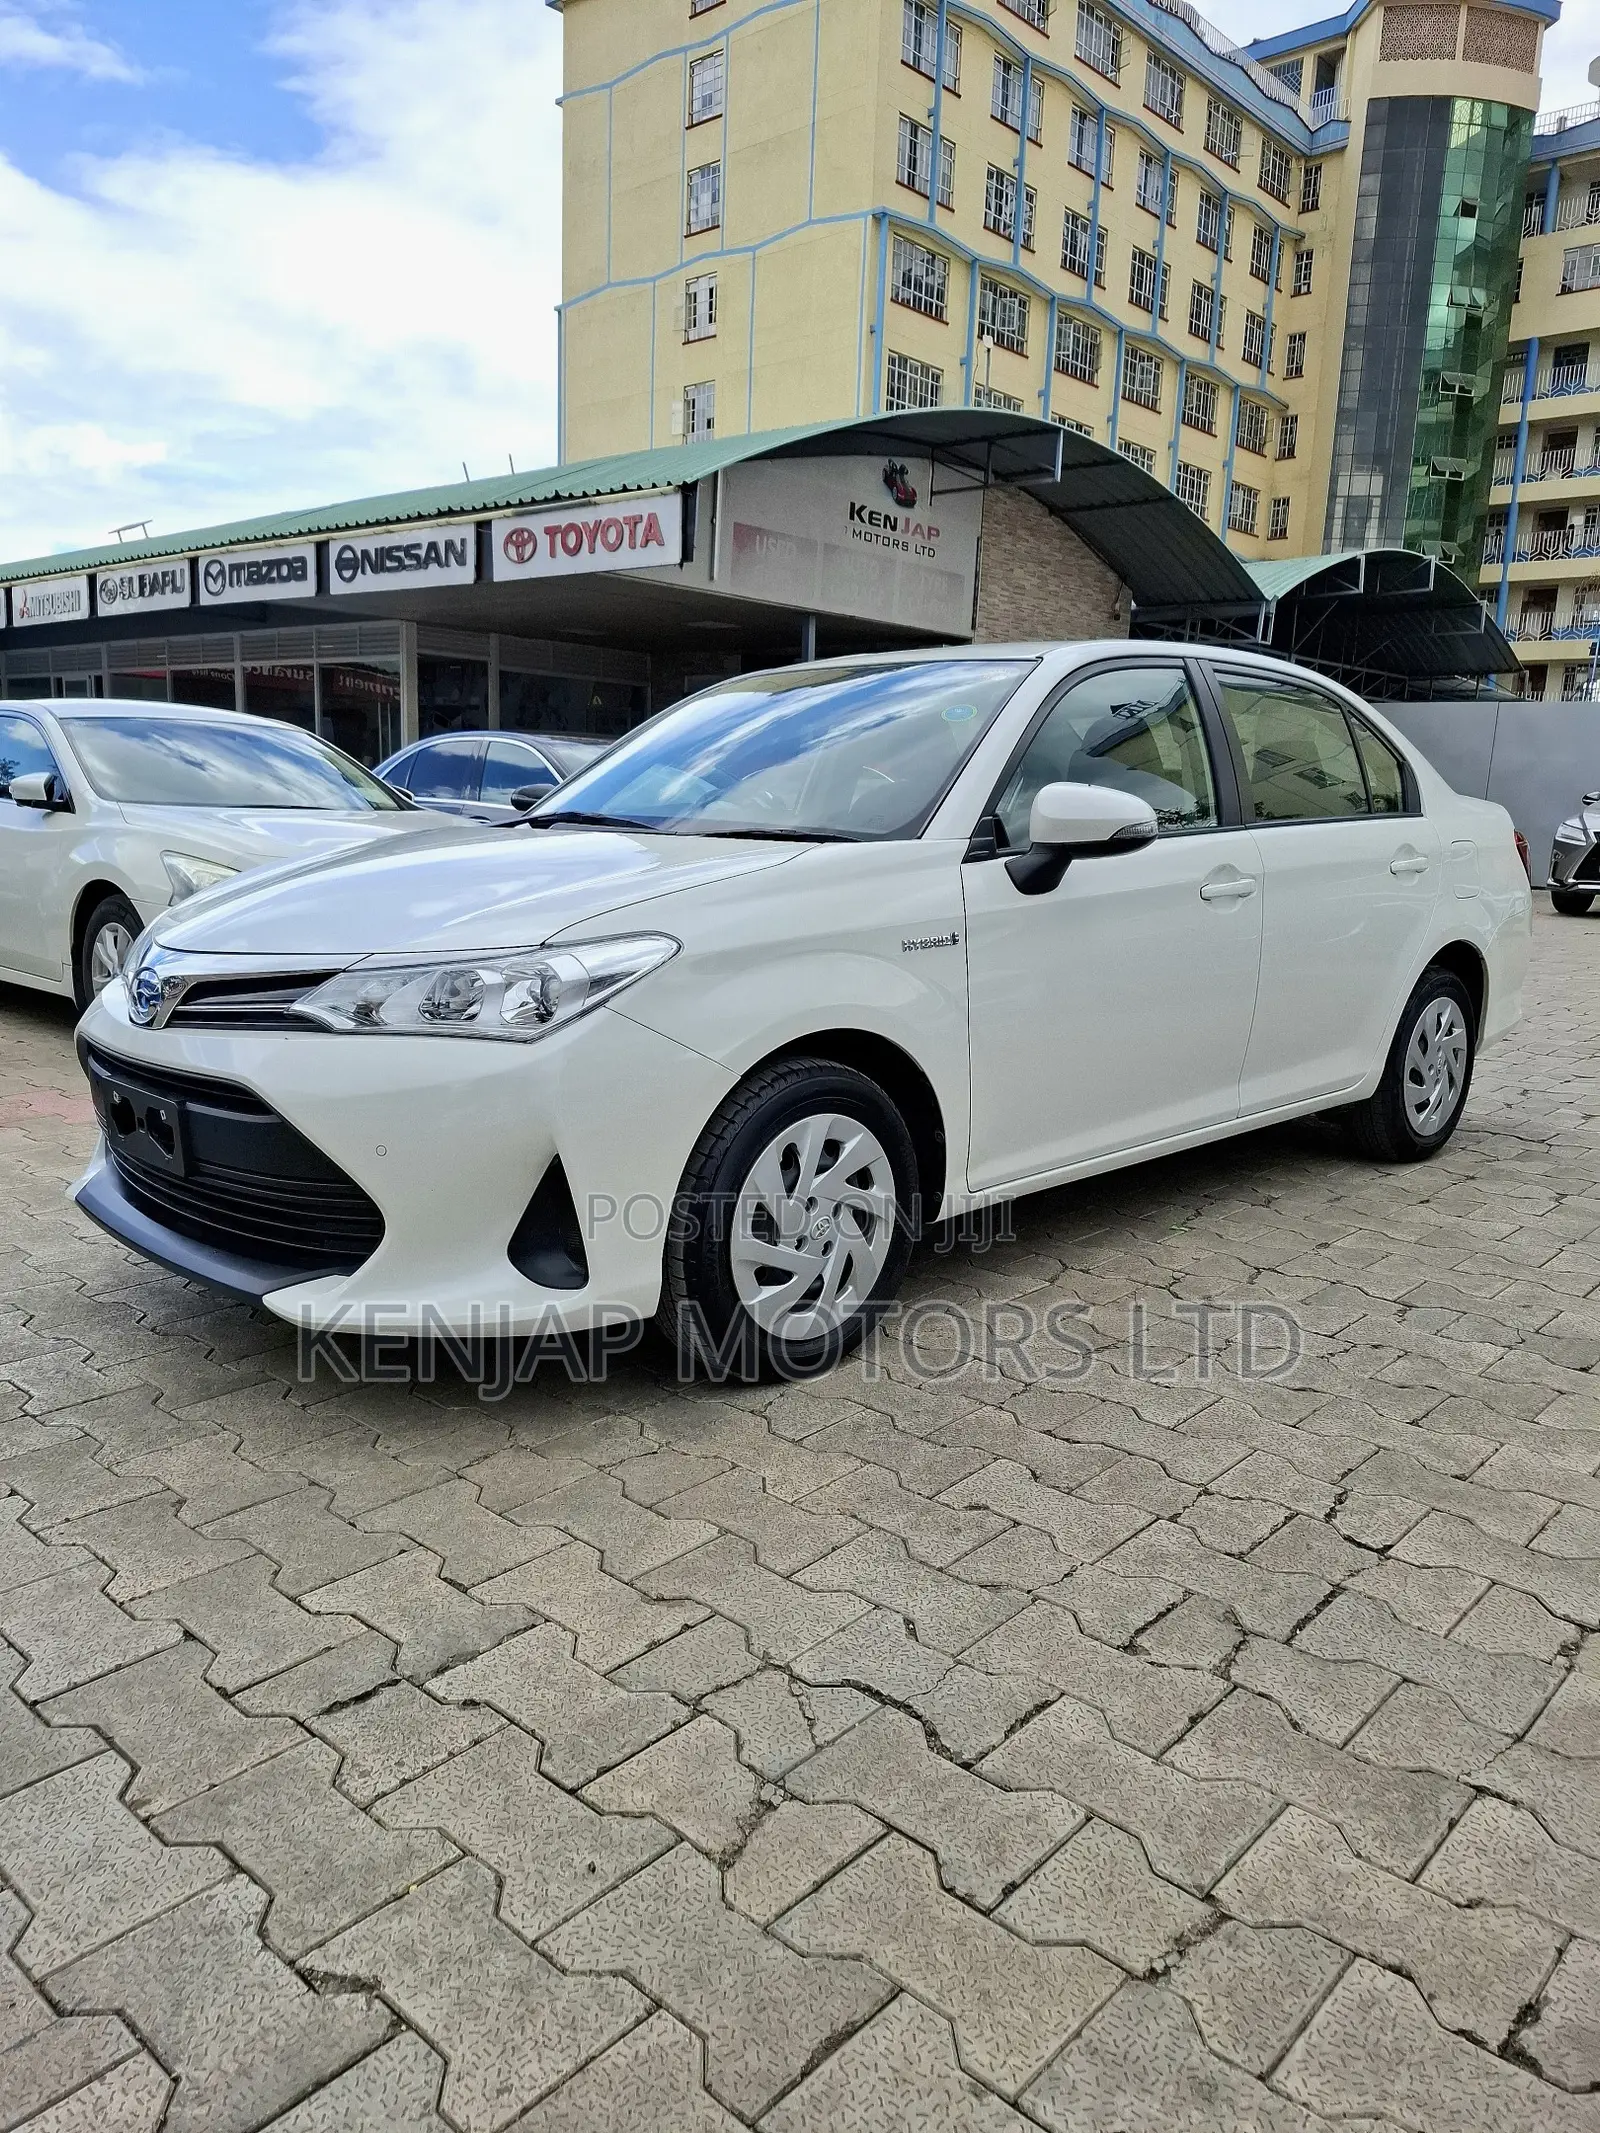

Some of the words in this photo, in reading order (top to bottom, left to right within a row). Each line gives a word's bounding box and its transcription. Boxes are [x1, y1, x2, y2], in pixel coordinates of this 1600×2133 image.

[543, 512, 665, 559] TOYOTA
[852, 527, 909, 552] MOTORS
[914, 543, 936, 558] LTD
[360, 538, 468, 576] NISSAN
[118, 566, 186, 600] SUBARU
[28, 590, 81, 618] MITSUBISHI
[901, 934, 951, 953] HYBRID
